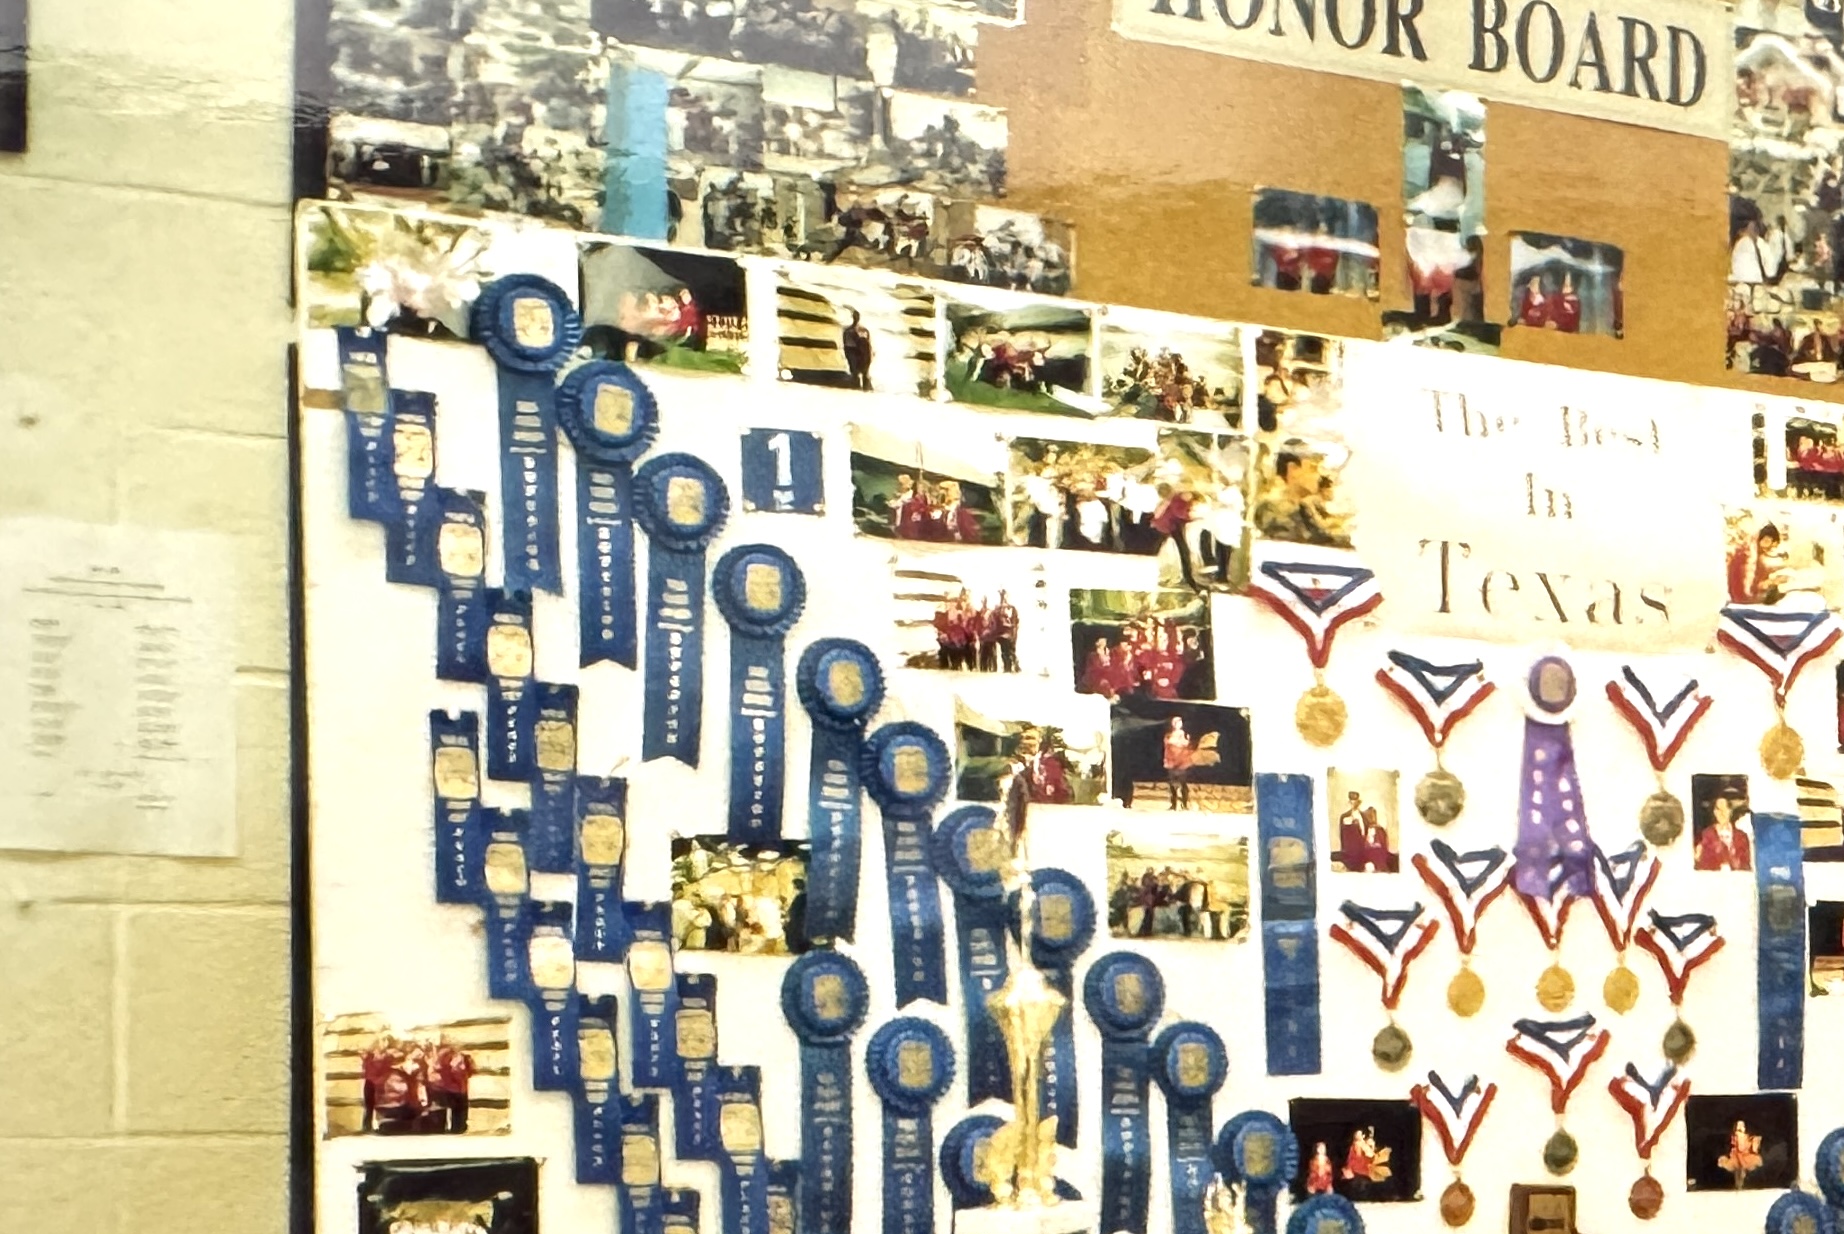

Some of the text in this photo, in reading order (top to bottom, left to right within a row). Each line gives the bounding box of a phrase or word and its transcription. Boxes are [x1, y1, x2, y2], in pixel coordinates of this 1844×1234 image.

[1148, 0, 1708, 108] NOR BOARD
[1411, 387, 1520, 438] The
[1417, 538, 1674, 626] Texas
